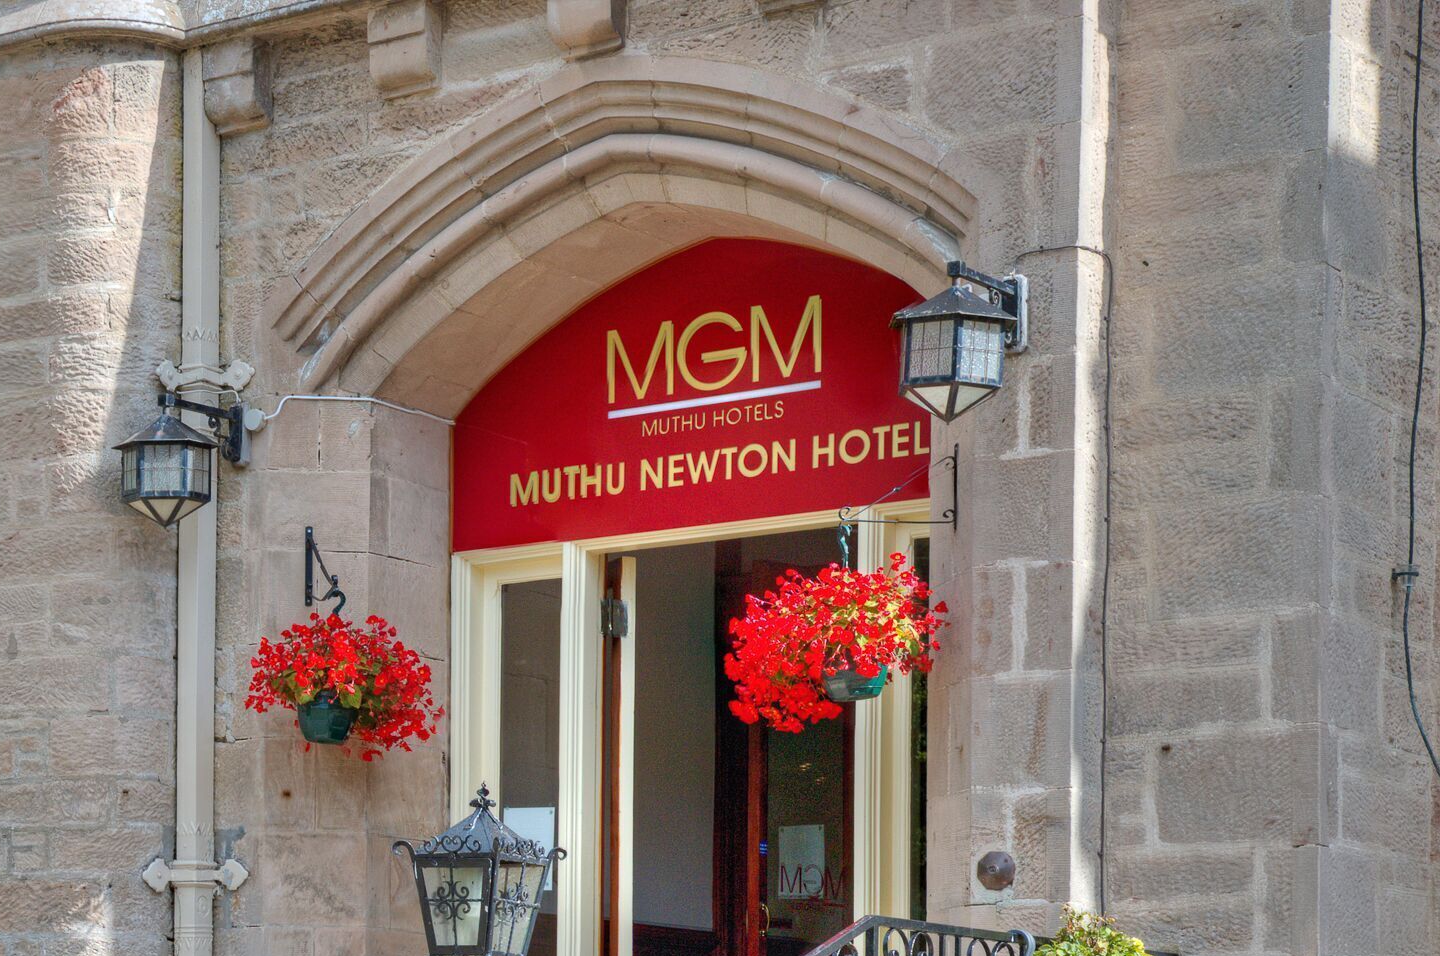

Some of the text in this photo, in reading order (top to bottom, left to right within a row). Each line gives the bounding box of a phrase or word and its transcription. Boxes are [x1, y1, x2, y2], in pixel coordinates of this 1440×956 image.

[607, 295, 822, 403] MGM
[641, 401, 785, 437] MUTHU HOTELS
[509, 421, 930, 507] MUTHU NEWTON HOTEL
